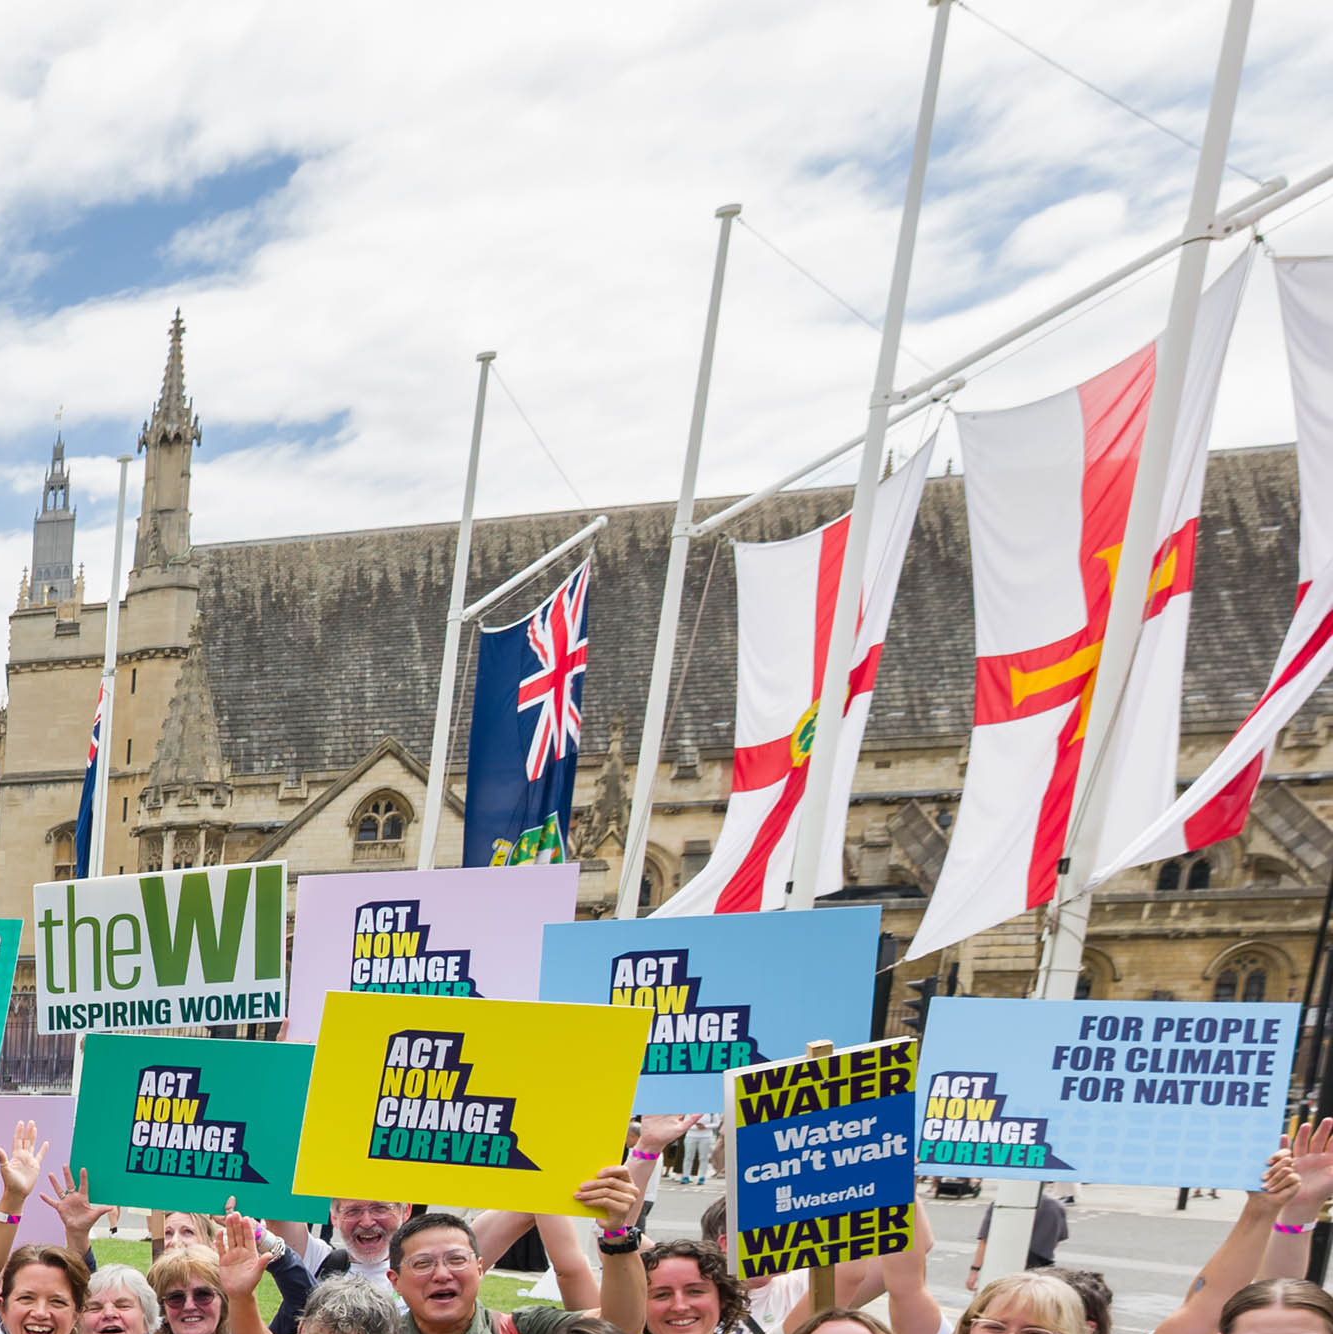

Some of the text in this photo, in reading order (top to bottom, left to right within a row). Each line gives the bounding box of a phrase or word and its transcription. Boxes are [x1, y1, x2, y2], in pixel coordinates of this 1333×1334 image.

[48, 991, 281, 1031] INSPIRING WOMEN
[1079, 1015, 1280, 1045] FOR PEOPLE
[388, 1037, 453, 1069] ACT
[1052, 1046, 1275, 1075] FOR CLIMATE
[139, 1072, 192, 1098] ACT
[382, 1067, 460, 1099] NOW
[930, 1077, 988, 1098] ACT
[1061, 1077, 1270, 1107] FOR NATURE
[136, 1097, 199, 1123] NOW
[376, 1098, 503, 1134] CHANGE
[926, 1097, 997, 1121] NOW
[132, 1122, 236, 1152] CHANGE
[371, 1128, 511, 1165] FOREVER
[774, 1116, 877, 1151] Water
[923, 1120, 1036, 1145] CHANGE
[131, 1147, 243, 1180] FOREVER
[832, 1133, 907, 1167] wait
[919, 1141, 1046, 1168] FOREVER
[791, 1183, 875, 1209] WaterAid
